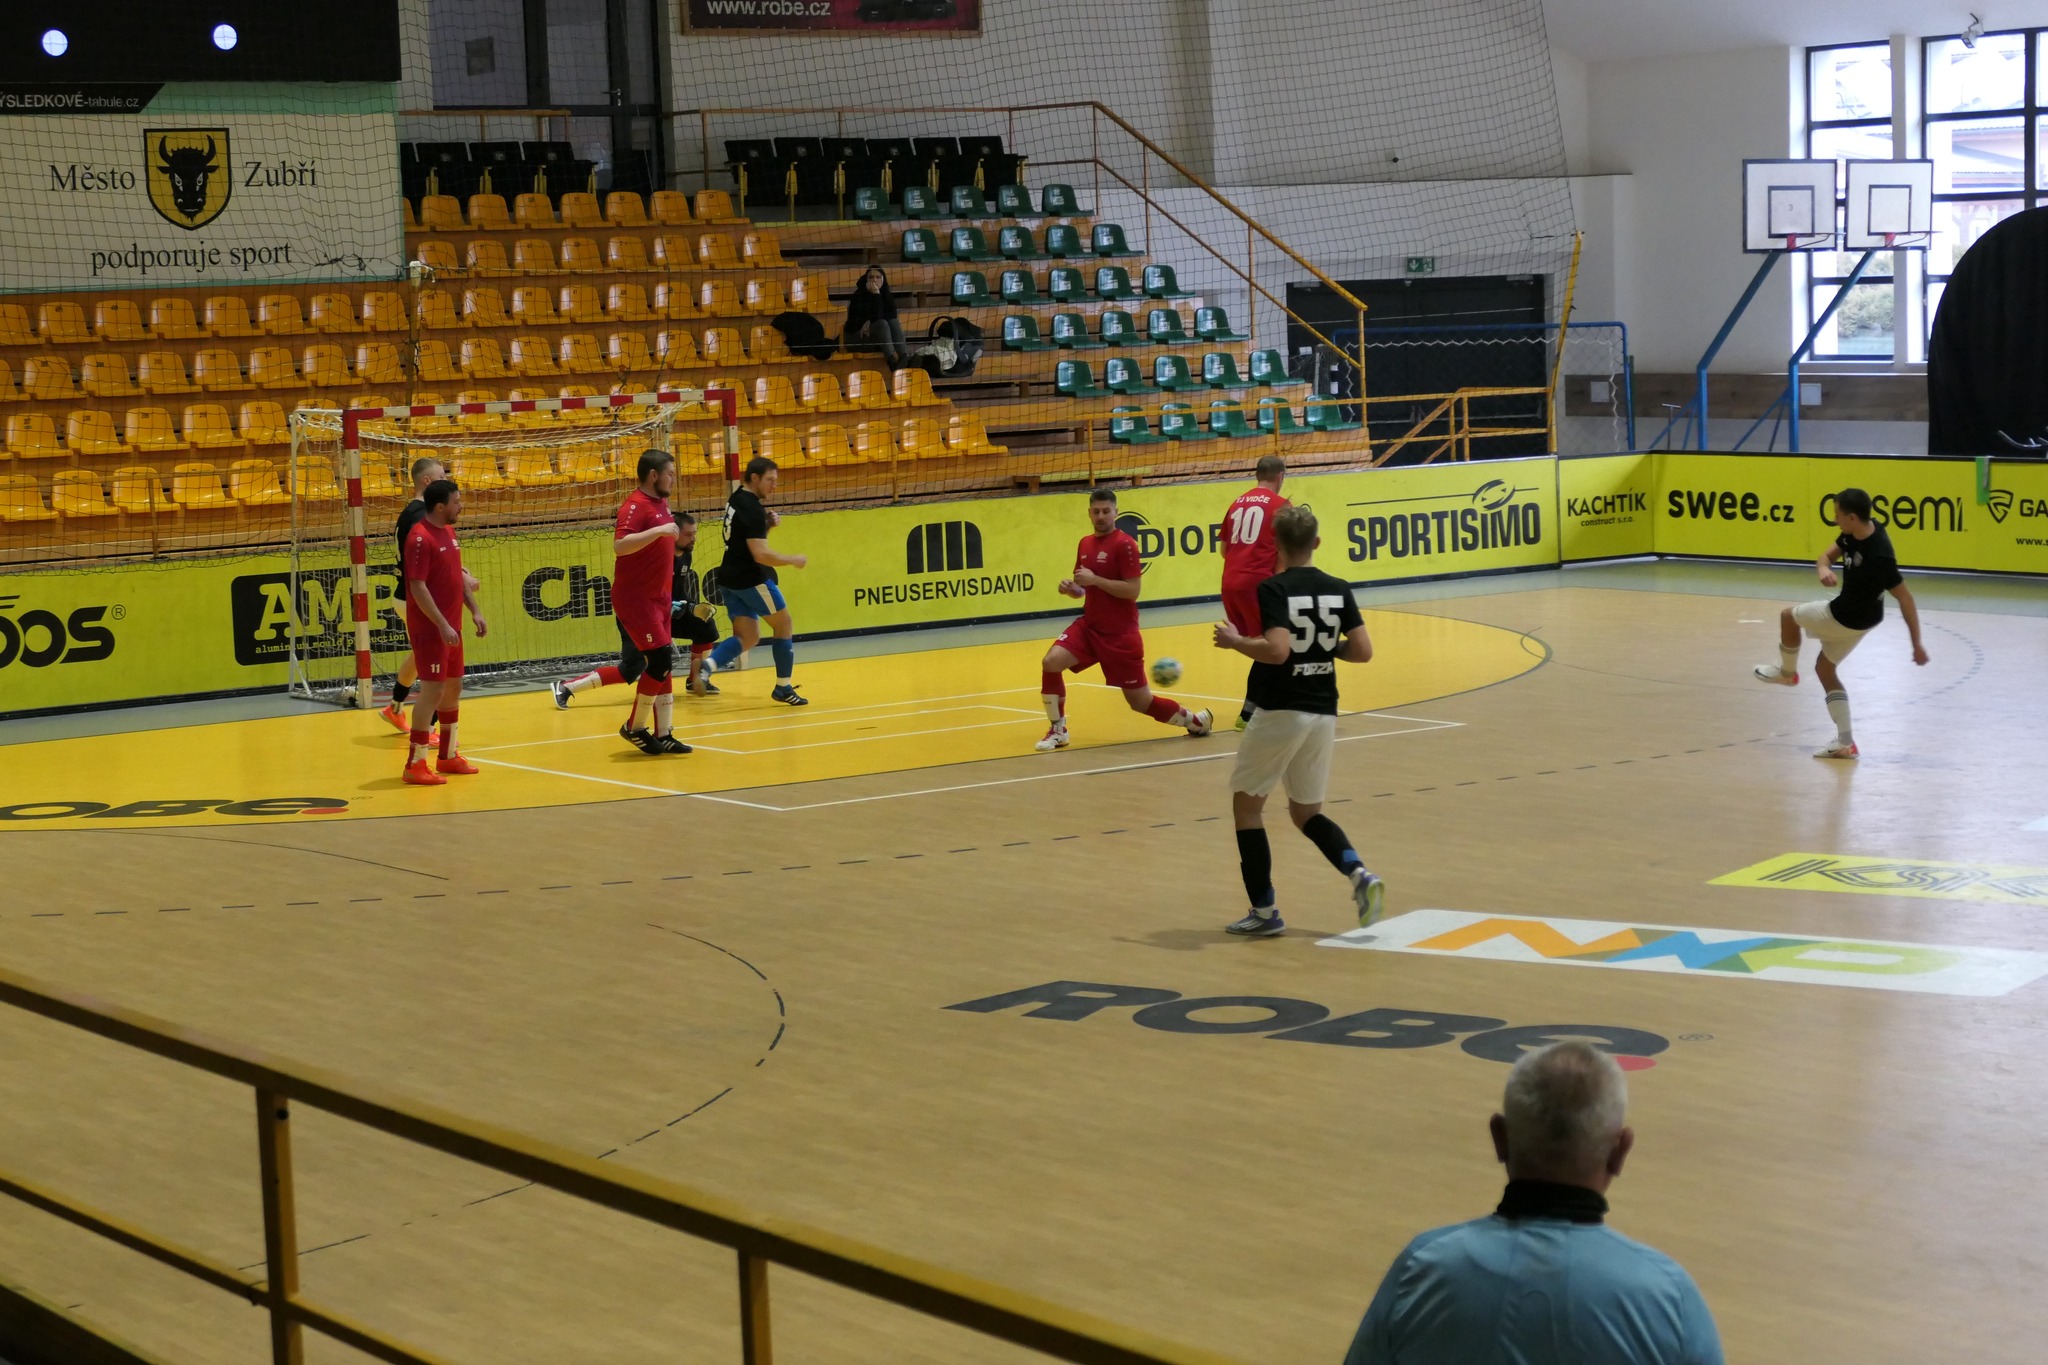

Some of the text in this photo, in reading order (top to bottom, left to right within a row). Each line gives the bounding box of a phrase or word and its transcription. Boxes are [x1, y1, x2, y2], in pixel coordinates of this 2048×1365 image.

[707, 0, 831, 16] www.robe.cz
[49, 160, 317, 191] Město Zubří
[90, 241, 292, 277] podporuje sport
[1567, 488, 1646, 517] KACHTÍK
[1668, 489, 1795, 523] swee.cz
[1231, 506, 1264, 544] 10
[1347, 503, 1541, 562] SPORTISIMO
[1581, 516, 1615, 527] construct
[646, 633, 653, 643] 5
[1287, 595, 1344, 653] 55
[254, 641, 309, 654] aluminum
[430, 663, 440, 674] 11
